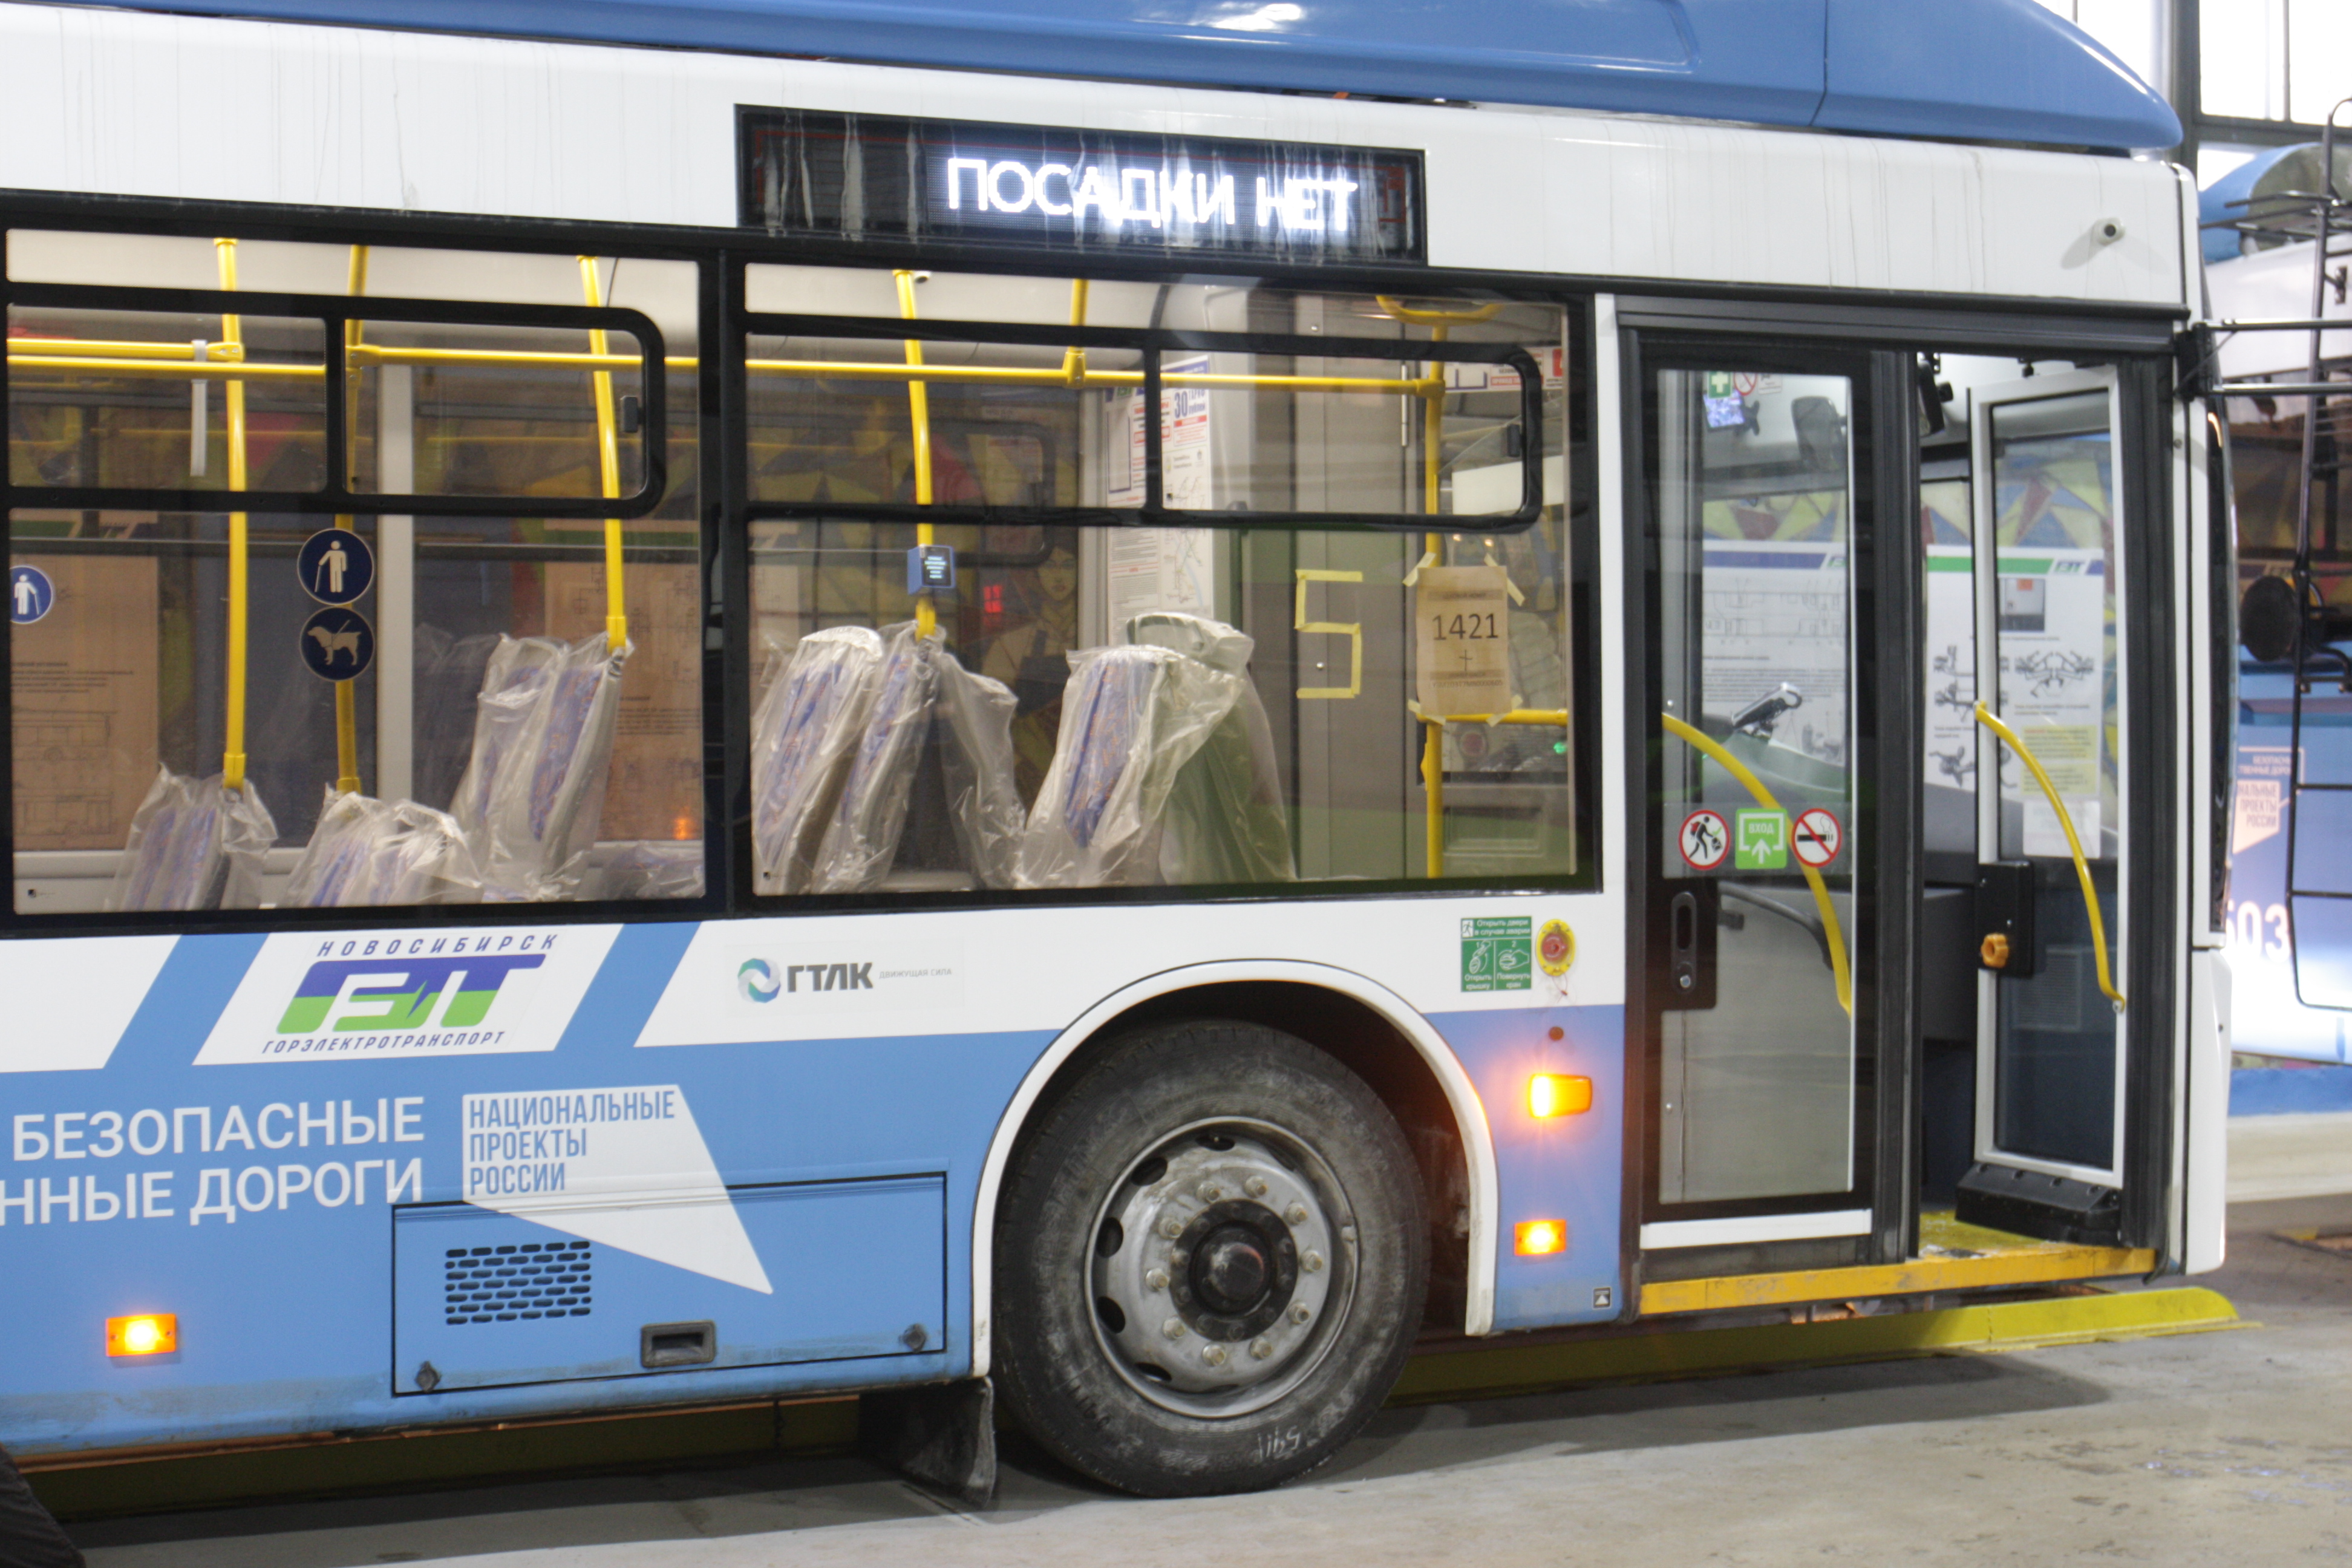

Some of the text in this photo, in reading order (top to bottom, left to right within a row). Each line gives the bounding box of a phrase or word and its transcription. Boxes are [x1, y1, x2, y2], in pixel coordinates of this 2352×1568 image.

[947, 158, 1359, 231] ПОСАДКИ НЕТ
[1174, 391, 1187, 419] 30
[1432, 612, 1499, 641] 1421
[1748, 822, 1774, 834] ВХОД
[318, 934, 558, 957] НОВОСИБИРСК
[788, 962, 952, 993] ГТЛК ДВИЖУЩАЯ СИЛА
[262, 1031, 506, 1054] ГОРЭЛЕКТРОТРАНСПОРТ
[469, 1090, 676, 1129] НАЦИОНАЛЬНЫЕ
[13, 1096, 425, 1161] БЕЗОПАСНЫЕ
[469, 1128, 587, 1162] ПРОЕКТЫ
[0, 1157, 423, 1227] ННЫЕ ДОРОГИ
[469, 1162, 566, 1196] РОССИИ
